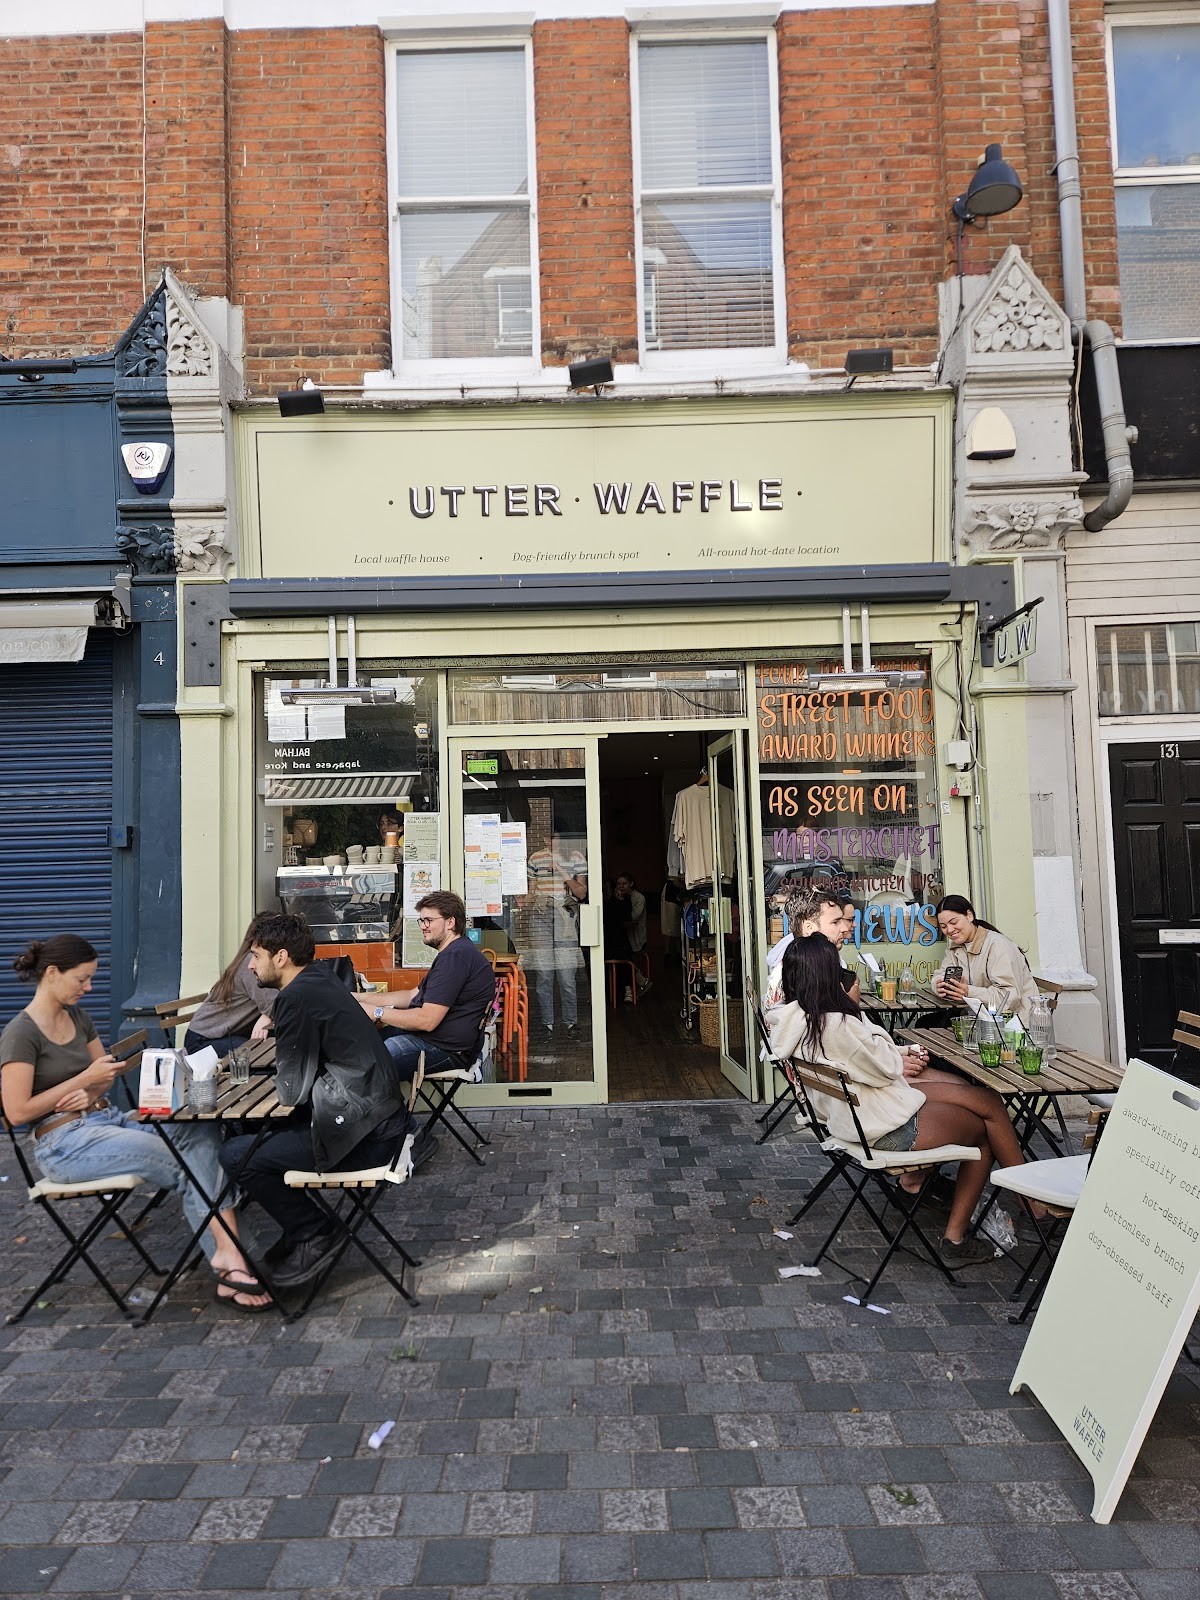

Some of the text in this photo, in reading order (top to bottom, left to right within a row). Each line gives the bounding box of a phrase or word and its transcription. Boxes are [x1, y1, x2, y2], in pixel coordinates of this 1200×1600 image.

[409, 478, 783, 518] UTTER WAFFLE
[354, 553, 450, 565] Local waffle house
[512, 549, 640, 563] Dog-friendly brunch spot
[698, 544, 840, 558] All-round hot-date location
[153, 651, 165, 666] 4
[757, 662, 807, 688] FOUR
[760, 687, 935, 728] STREET FOOD
[761, 730, 937, 761] AWARD WINNERS
[1160, 743, 1180, 758] 131
[768, 786, 799, 817] AS
[807, 784, 865, 816] SEEN
[773, 824, 941, 863] MASTERCHEF
[852, 874, 906, 893] KITCHEN
[1122, 1108, 1189, 1153] award-winning
[1125, 1145, 1177, 1185] speciality
[1142, 1193, 1200, 1243] hot-desking
[1103, 1202, 1185, 1275] bottomless brunch
[1088, 1231, 1173, 1309] dog-obsessed staff
[1073, 1416, 1104, 1463] WAFFLE
[1081, 1405, 1106, 1444] UTTER
